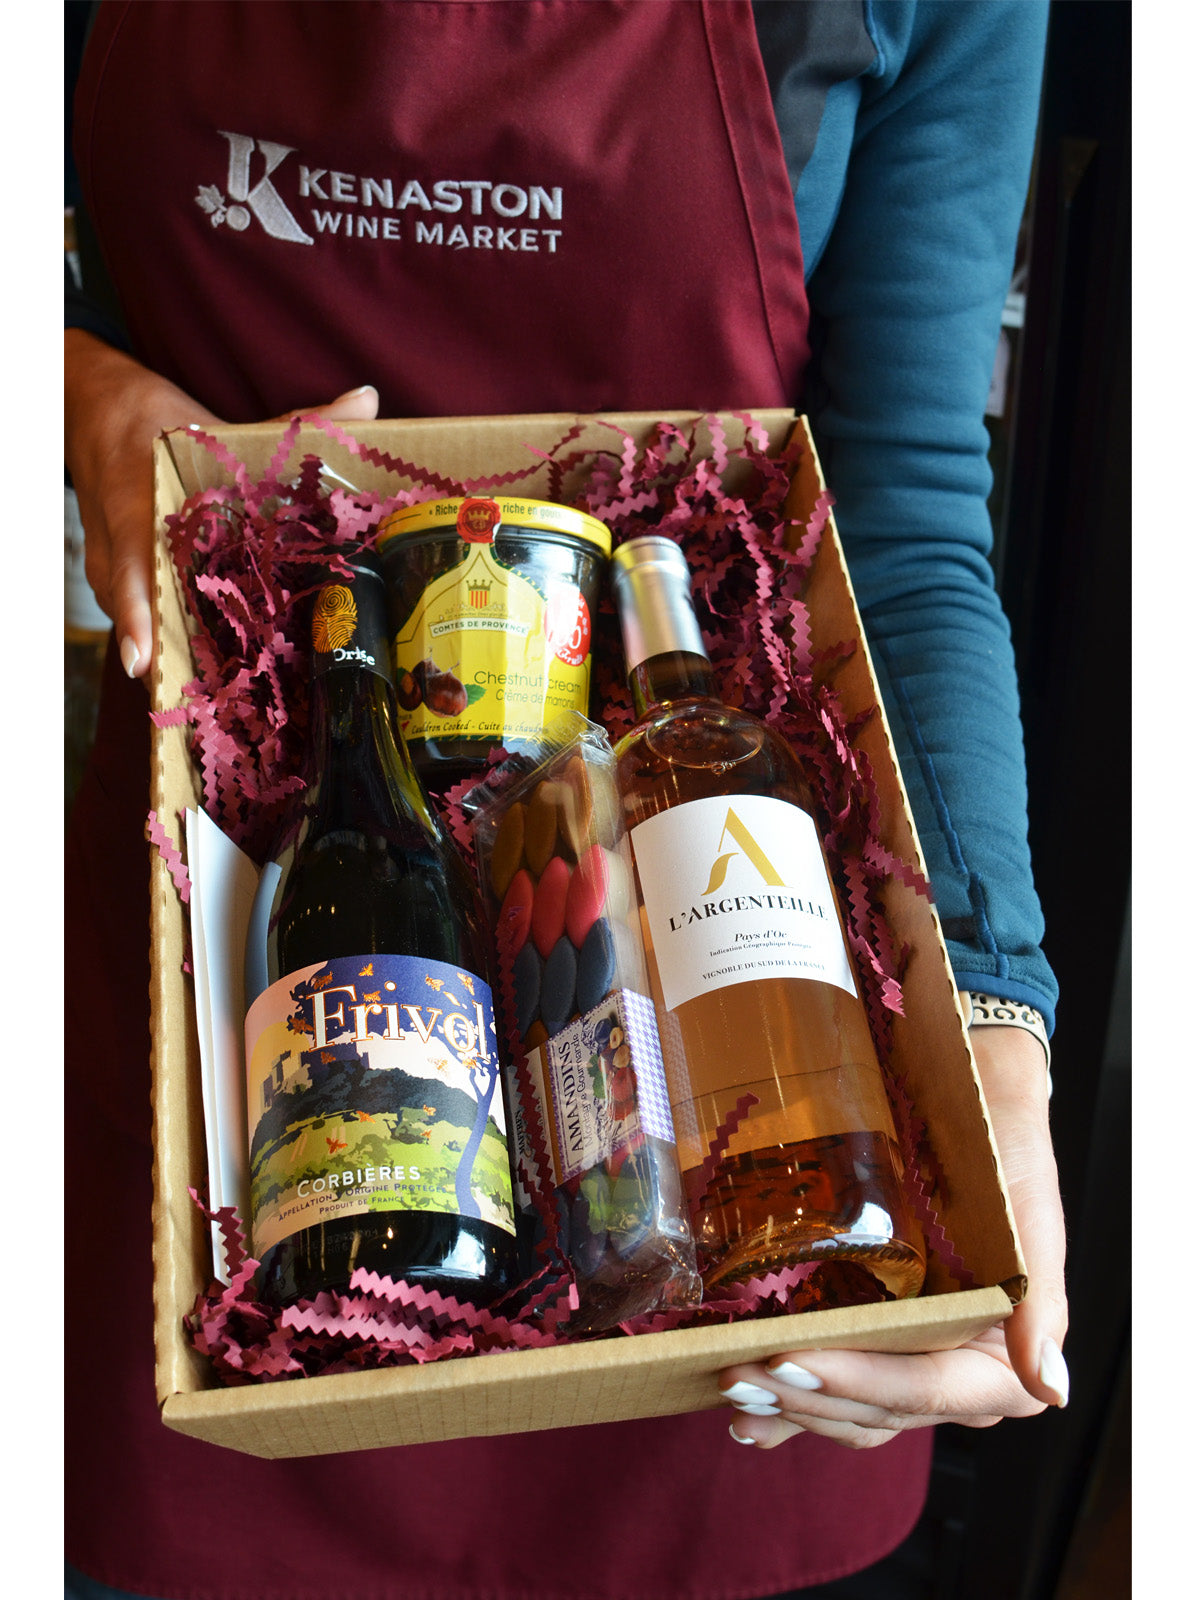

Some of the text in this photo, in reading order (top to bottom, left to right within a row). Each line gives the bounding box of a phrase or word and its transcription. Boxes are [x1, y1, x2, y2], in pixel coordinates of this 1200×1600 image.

[300, 165, 563, 220] KENASTON
[311, 208, 563, 253] WINE MARKET
[435, 503, 458, 516] Riche
[502, 502, 525, 515] riche
[433, 620, 527, 635] COMTES DE PROVENCE
[474, 670, 582, 694] Chestnut cream
[495, 688, 529, 703] Crème
[530, 693, 545, 704] de
[443, 719, 469, 732] Cooked
[478, 720, 500, 731] Cuite
[734, 931, 761, 944] Pays
[709, 945, 743, 957] Indication
[702, 965, 744, 980] VIGNOBLE
[306, 980, 491, 1062] Frivol
[558, 1041, 584, 1152] AMANDINS
[572, 1032, 595, 1148] Montagne Gourmande
[297, 1163, 421, 1198] CORBIÈRES
[278, 1193, 333, 1221] APPELLATION
[319, 1195, 405, 1214] PRODUIT DE FRANCE
